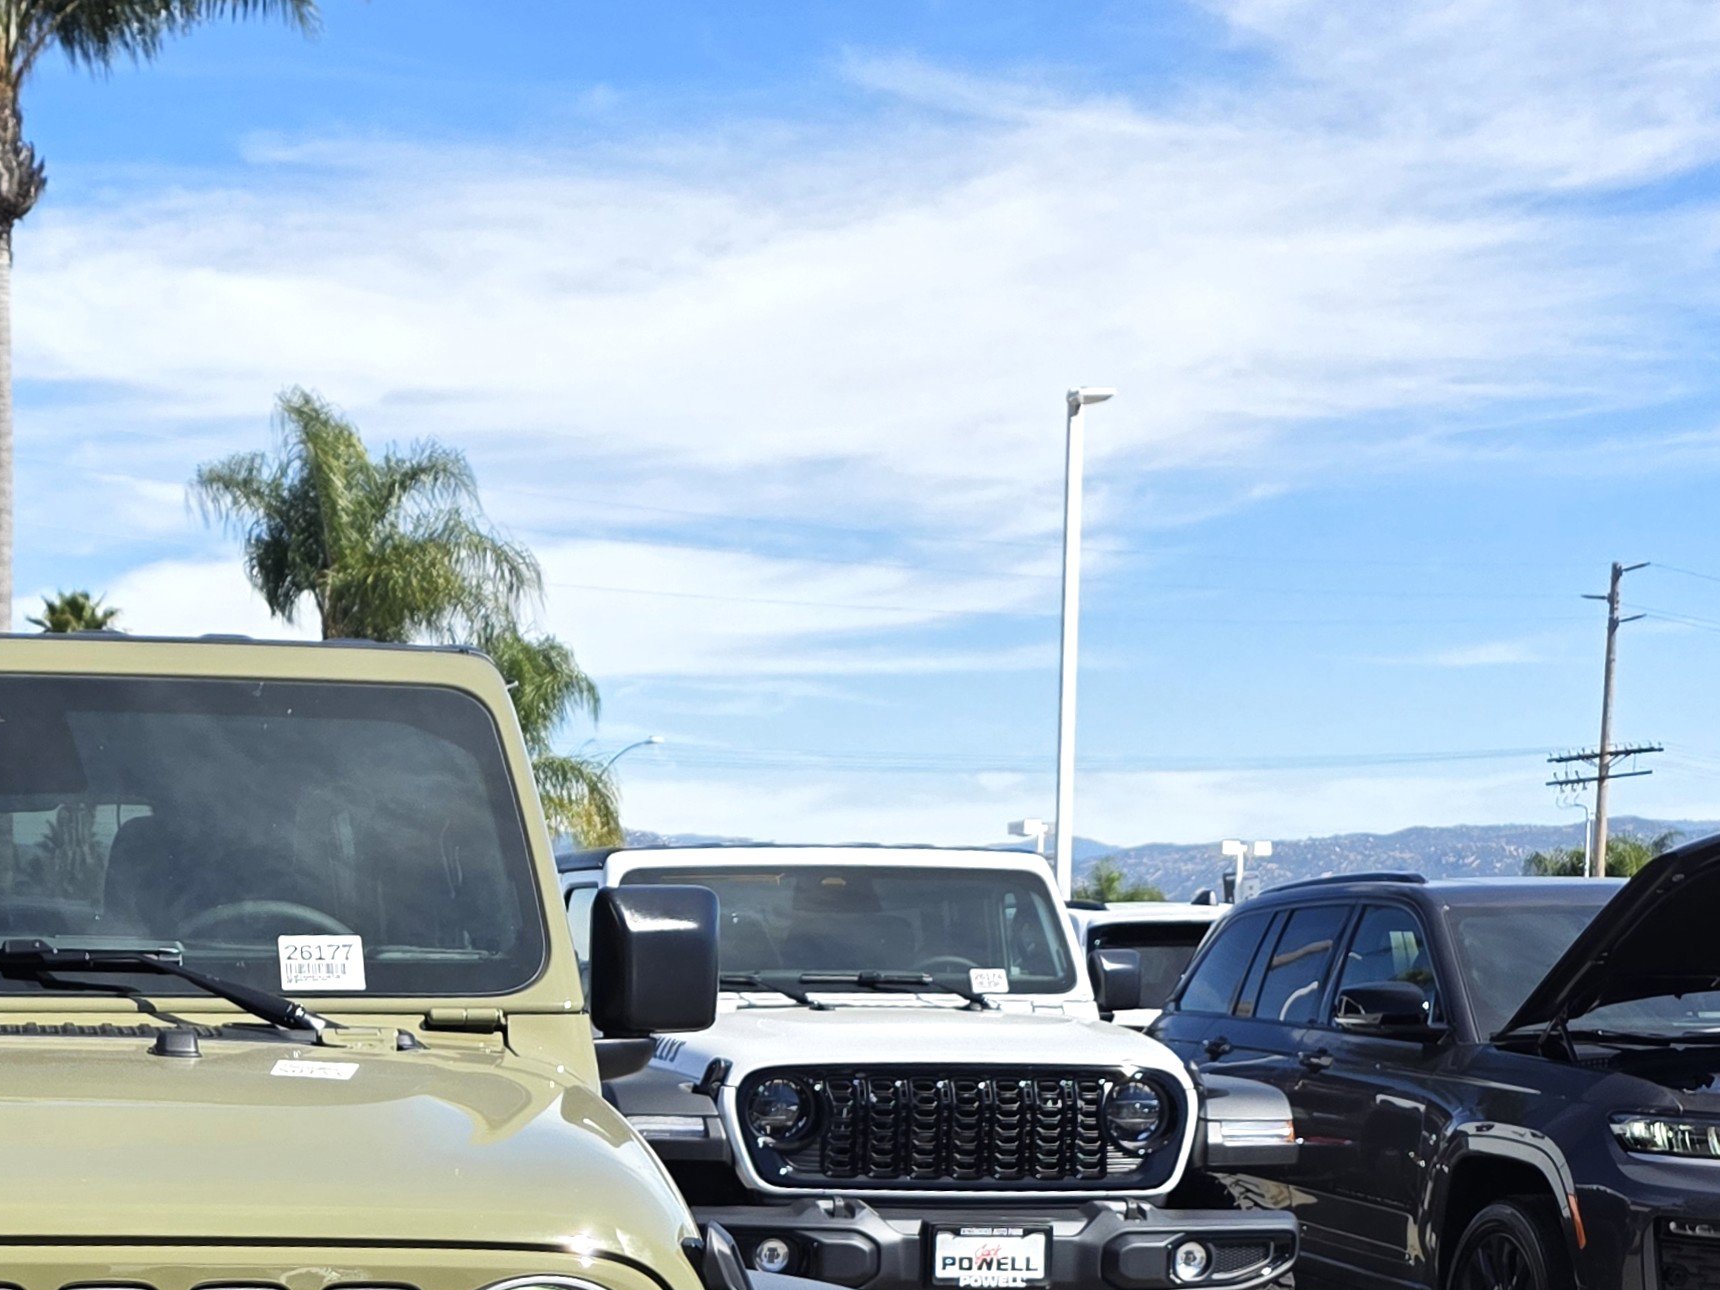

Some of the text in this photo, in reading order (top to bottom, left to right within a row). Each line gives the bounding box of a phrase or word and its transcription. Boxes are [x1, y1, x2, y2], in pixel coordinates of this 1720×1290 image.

[284, 944, 353, 961] 26177
[942, 1256, 1038, 1271] POWELL
[959, 1276, 1027, 1287] POWELL
